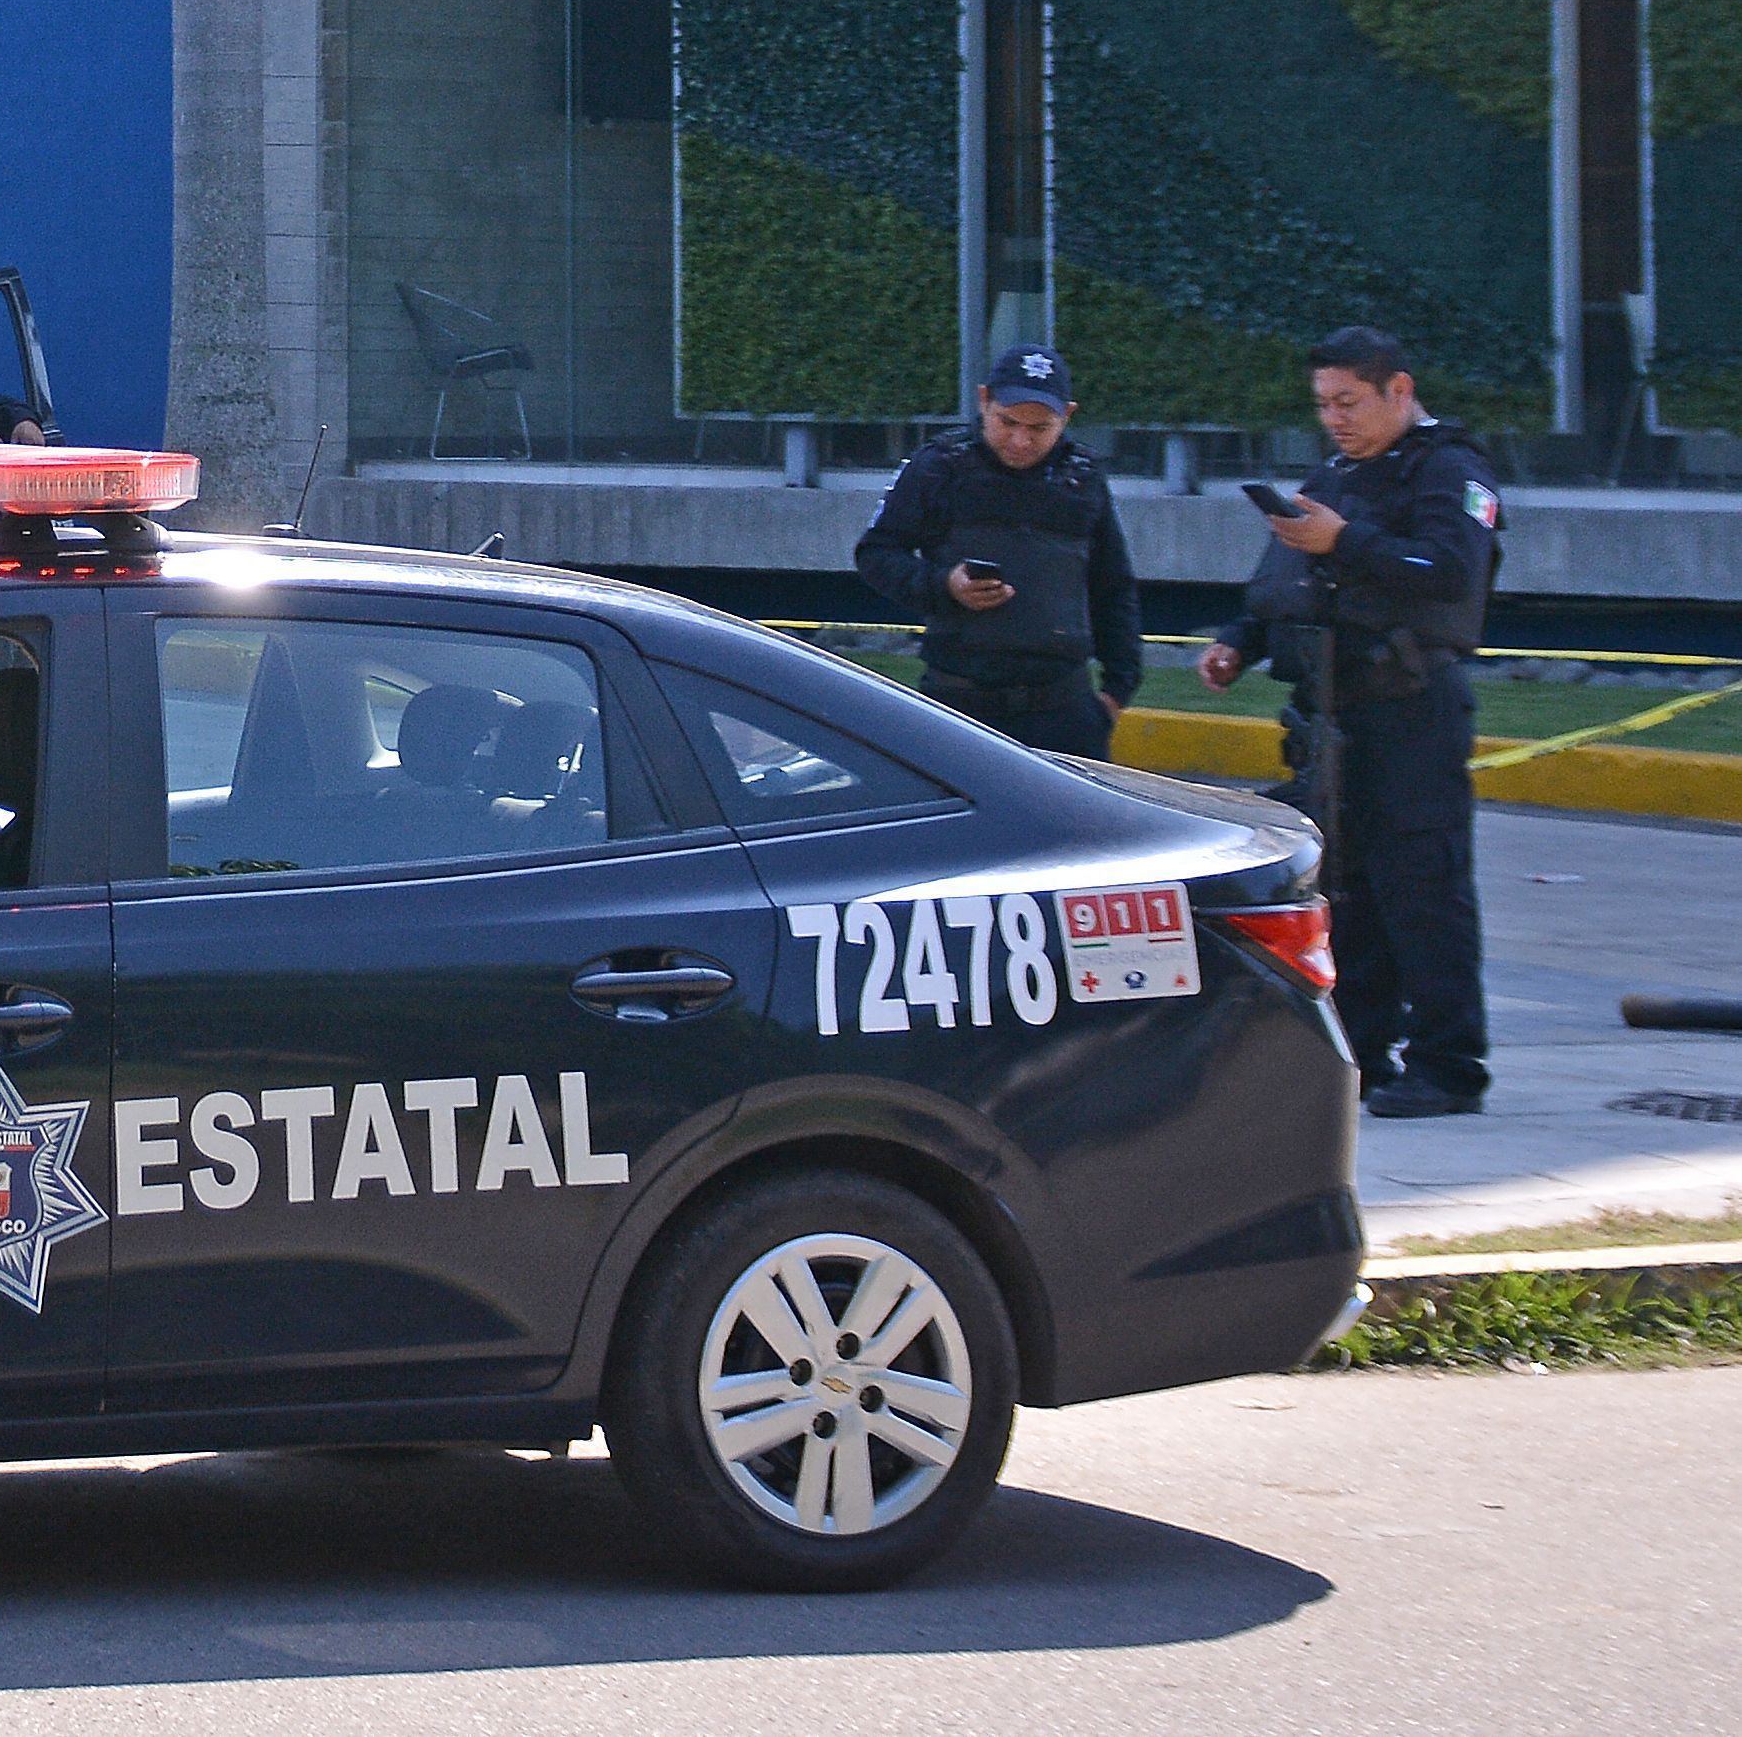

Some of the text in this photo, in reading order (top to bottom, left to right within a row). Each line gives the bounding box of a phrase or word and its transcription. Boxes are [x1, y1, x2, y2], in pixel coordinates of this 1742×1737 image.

[786, 893, 1058, 1036] 72478
[1071, 898, 1171, 933] 911
[114, 1071, 631, 1216] ESTATAL
